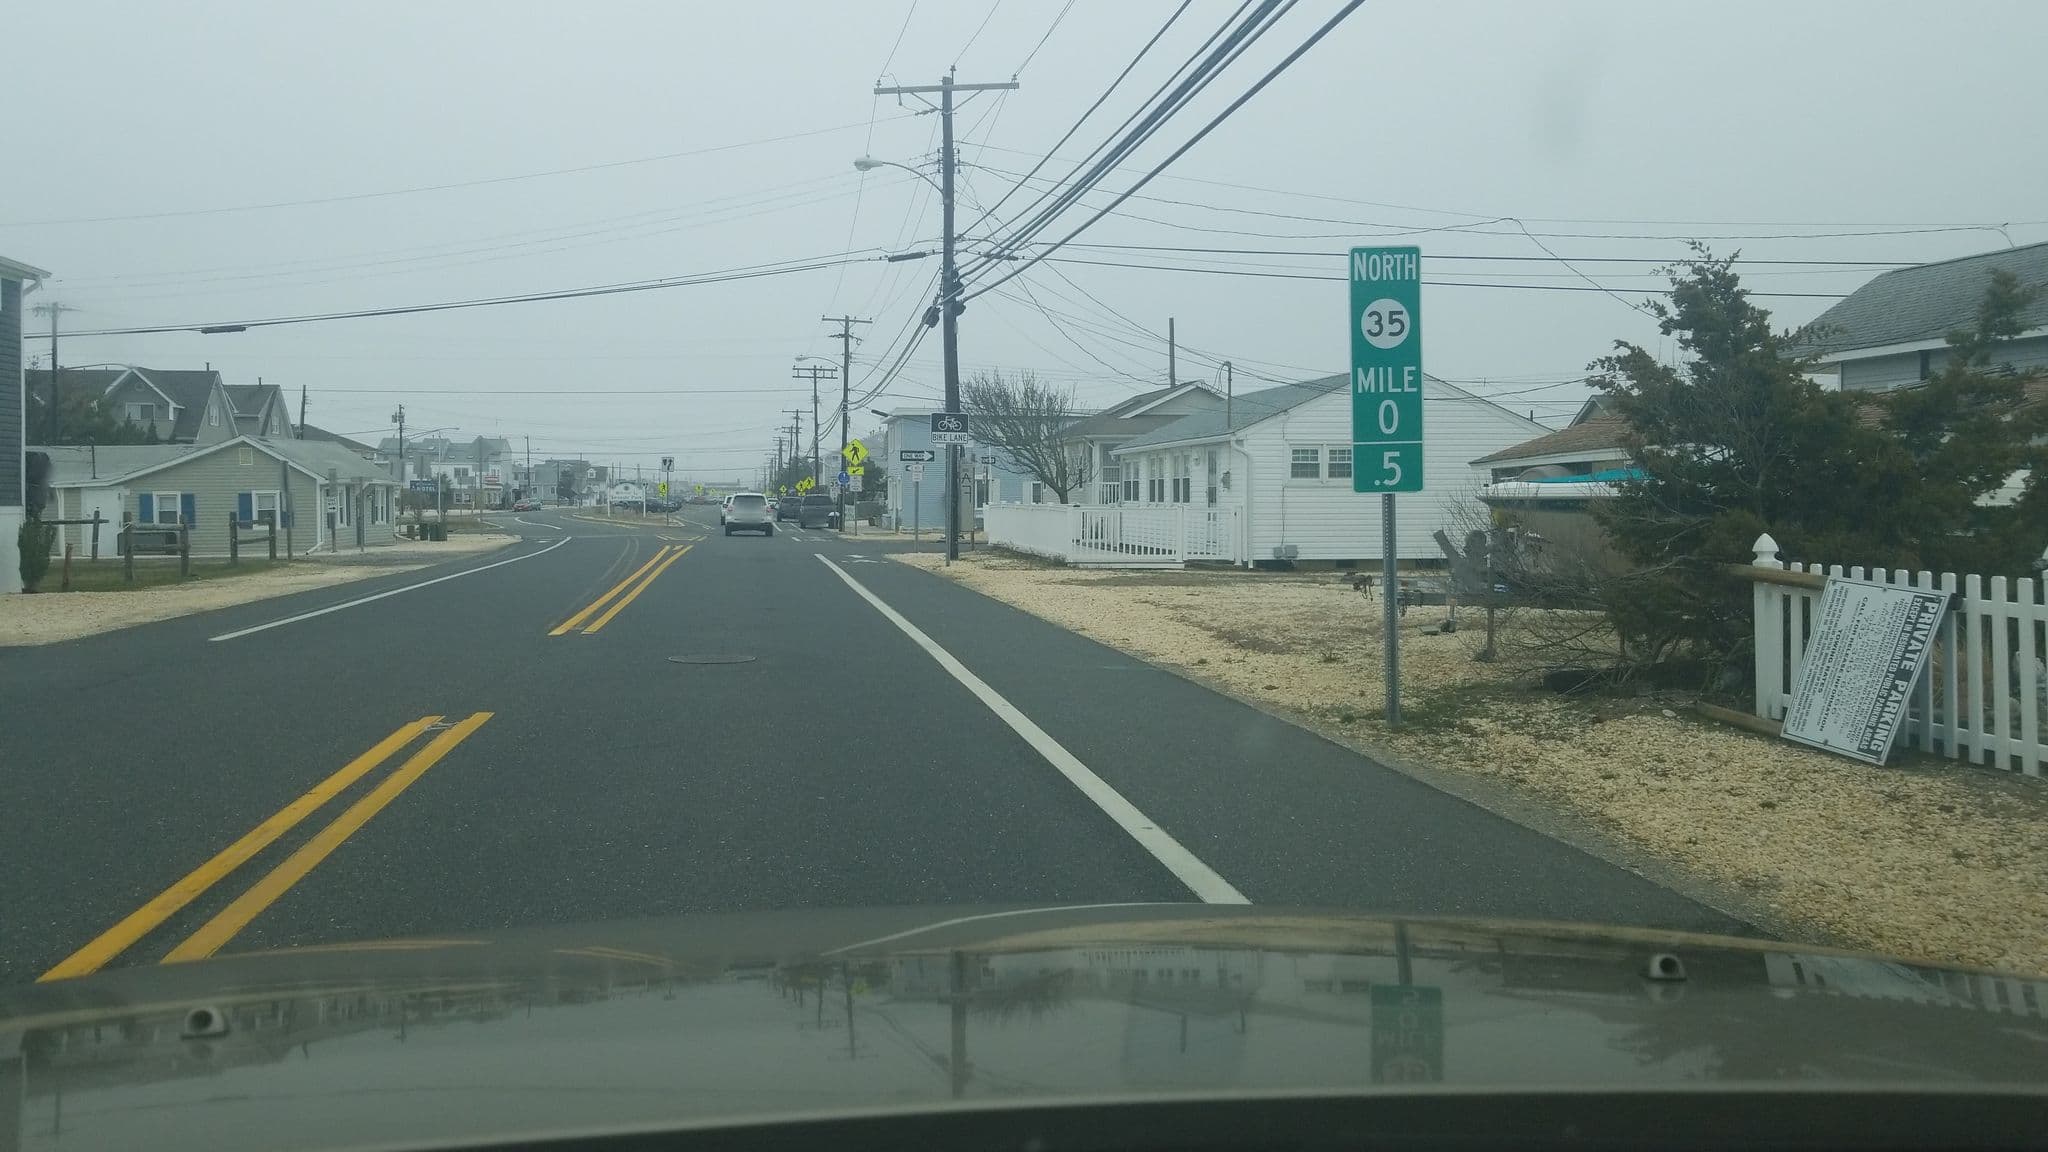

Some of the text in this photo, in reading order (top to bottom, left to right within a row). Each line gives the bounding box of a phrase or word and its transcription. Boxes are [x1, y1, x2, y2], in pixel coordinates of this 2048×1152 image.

[1353, 252, 1417, 281] NORTH
[1367, 310, 1405, 337] 35
[1357, 366, 1417, 394] MILE
[1378, 399, 1399, 434] 0
[932, 433, 967, 442] BIKE LANE
[1374, 451, 1402, 486] .5
[1857, 596, 1869, 616] CALL
[1905, 597, 1922, 622] EXCEPT
[1902, 623, 1913, 631] IN
[1827, 628, 1843, 664] TOWING
[1887, 632, 1909, 672] DESIGNATED
[1817, 665, 1830, 693] RATES
[1869, 601, 1939, 752] PRIVATE PARKING
[1878, 672, 1894, 697] PUBLIC
[1818, 675, 1841, 732] INFORMATION
[1867, 697, 1885, 727] PARKING
